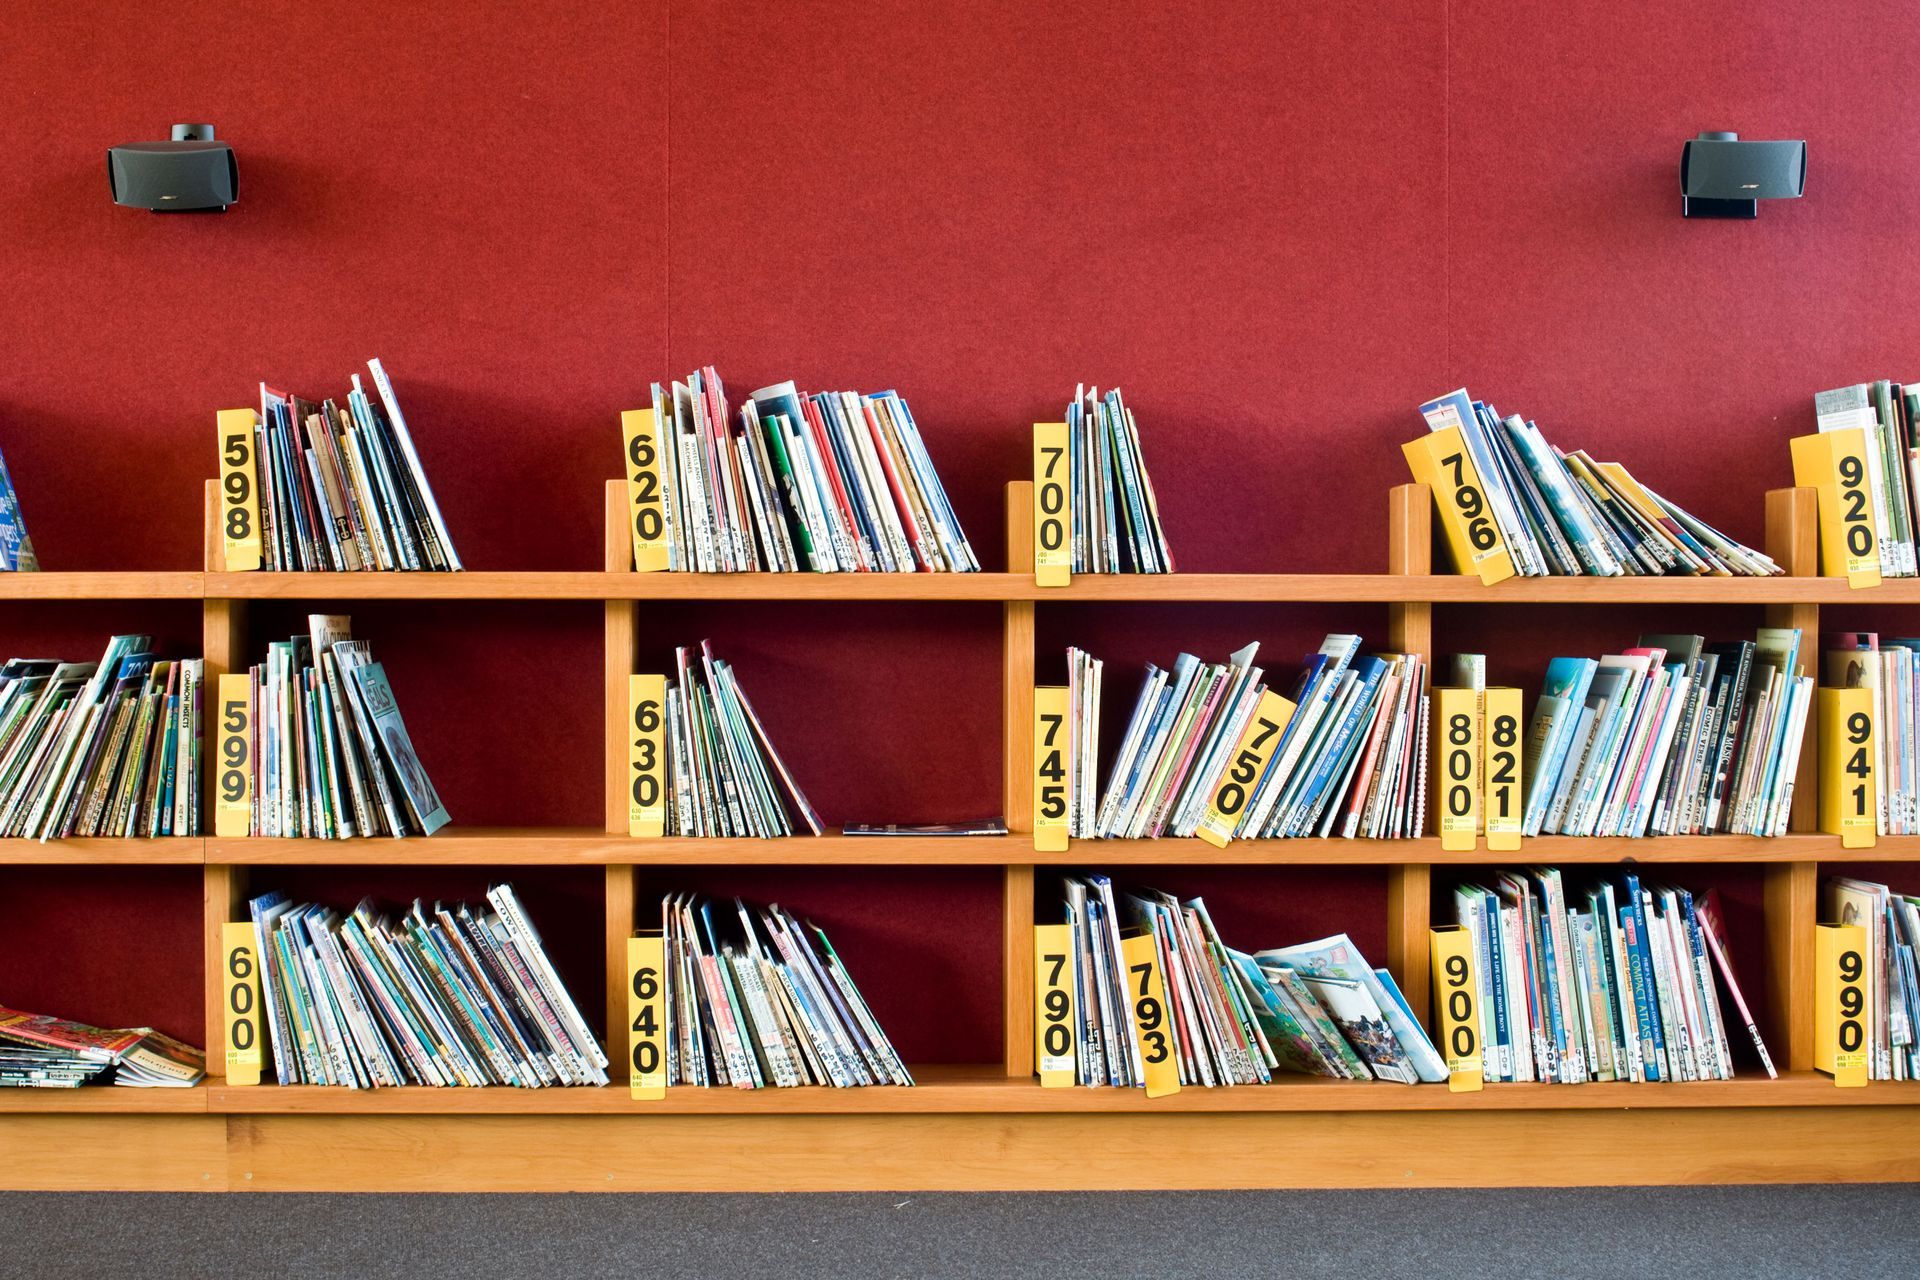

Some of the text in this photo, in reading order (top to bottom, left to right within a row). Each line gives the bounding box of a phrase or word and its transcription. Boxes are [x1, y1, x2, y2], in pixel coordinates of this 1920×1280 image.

[1109, 400, 1120, 427] WELCOME
[684, 441, 692, 473] MACHINES
[690, 442, 699, 468] WHEELS
[740, 443, 750, 463] TOOLS
[1117, 437, 1125, 449] THE
[1119, 449, 1130, 470] SOUTH
[225, 434, 250, 540] 598
[629, 434, 663, 541] 620
[1124, 470, 1133, 485] SEAS
[1040, 447, 1064, 551] 700
[1128, 485, 1144, 534] GREGORY O'BRIEN
[1441, 453, 1497, 551] 796
[1839, 456, 1873, 557] 920
[1737, 659, 1749, 690] KINGFISHER
[181, 669, 191, 728] COMMON INSECTS
[1331, 671, 1379, 754] THE WORLD OF Music
[1397, 685, 1409, 715] PRINTING
[1680, 671, 1702, 742] THE NIGHT KITE
[1732, 708, 1739, 716] OF
[1734, 691, 1742, 707] BOOK
[222, 700, 247, 802] 599
[632, 700, 660, 807] 630
[1695, 708, 1712, 764] COMIC VERSE
[1720, 736, 1734, 765] MUSIC
[1039, 714, 1066, 819] 745
[1217, 717, 1280, 815] 750
[1449, 714, 1472, 817] 800
[1491, 715, 1517, 818] 821
[1846, 712, 1871, 816] 941
[494, 898, 518, 935] COWS
[1632, 890, 1642, 925] SHIPWRECKS
[1571, 916, 1580, 947] EXPLORING
[1626, 918, 1635, 943] COLLINS
[1685, 928, 1696, 958] EXPLORING
[483, 948, 513, 994] TECHNOLOGY
[502, 941, 522, 967] Giant
[531, 989, 542, 1000] of
[537, 1000, 557, 1025] CARD
[738, 973, 748, 989] METAL
[744, 972, 757, 993] PLASTIC
[751, 974, 761, 991] GLASS
[780, 972, 800, 1008] PACKAGING
[839, 981, 851, 999] WOOD
[1495, 974, 1501, 982] ON
[1624, 970, 1632, 991] Globes
[229, 947, 254, 1050] 600
[351, 998, 361, 1012] MIND
[1044, 954, 1071, 1057] 790
[1130, 962, 1169, 1064] 793
[1445, 955, 1475, 1058] 900
[1550, 973, 1560, 1014] GEOGRAPHY
[1609, 995, 1618, 1023] TWENTIES
[1630, 953, 1651, 1037] COMPACT ATLAS
[1839, 950, 1864, 1053] 990
[632, 967, 660, 1074] 640
